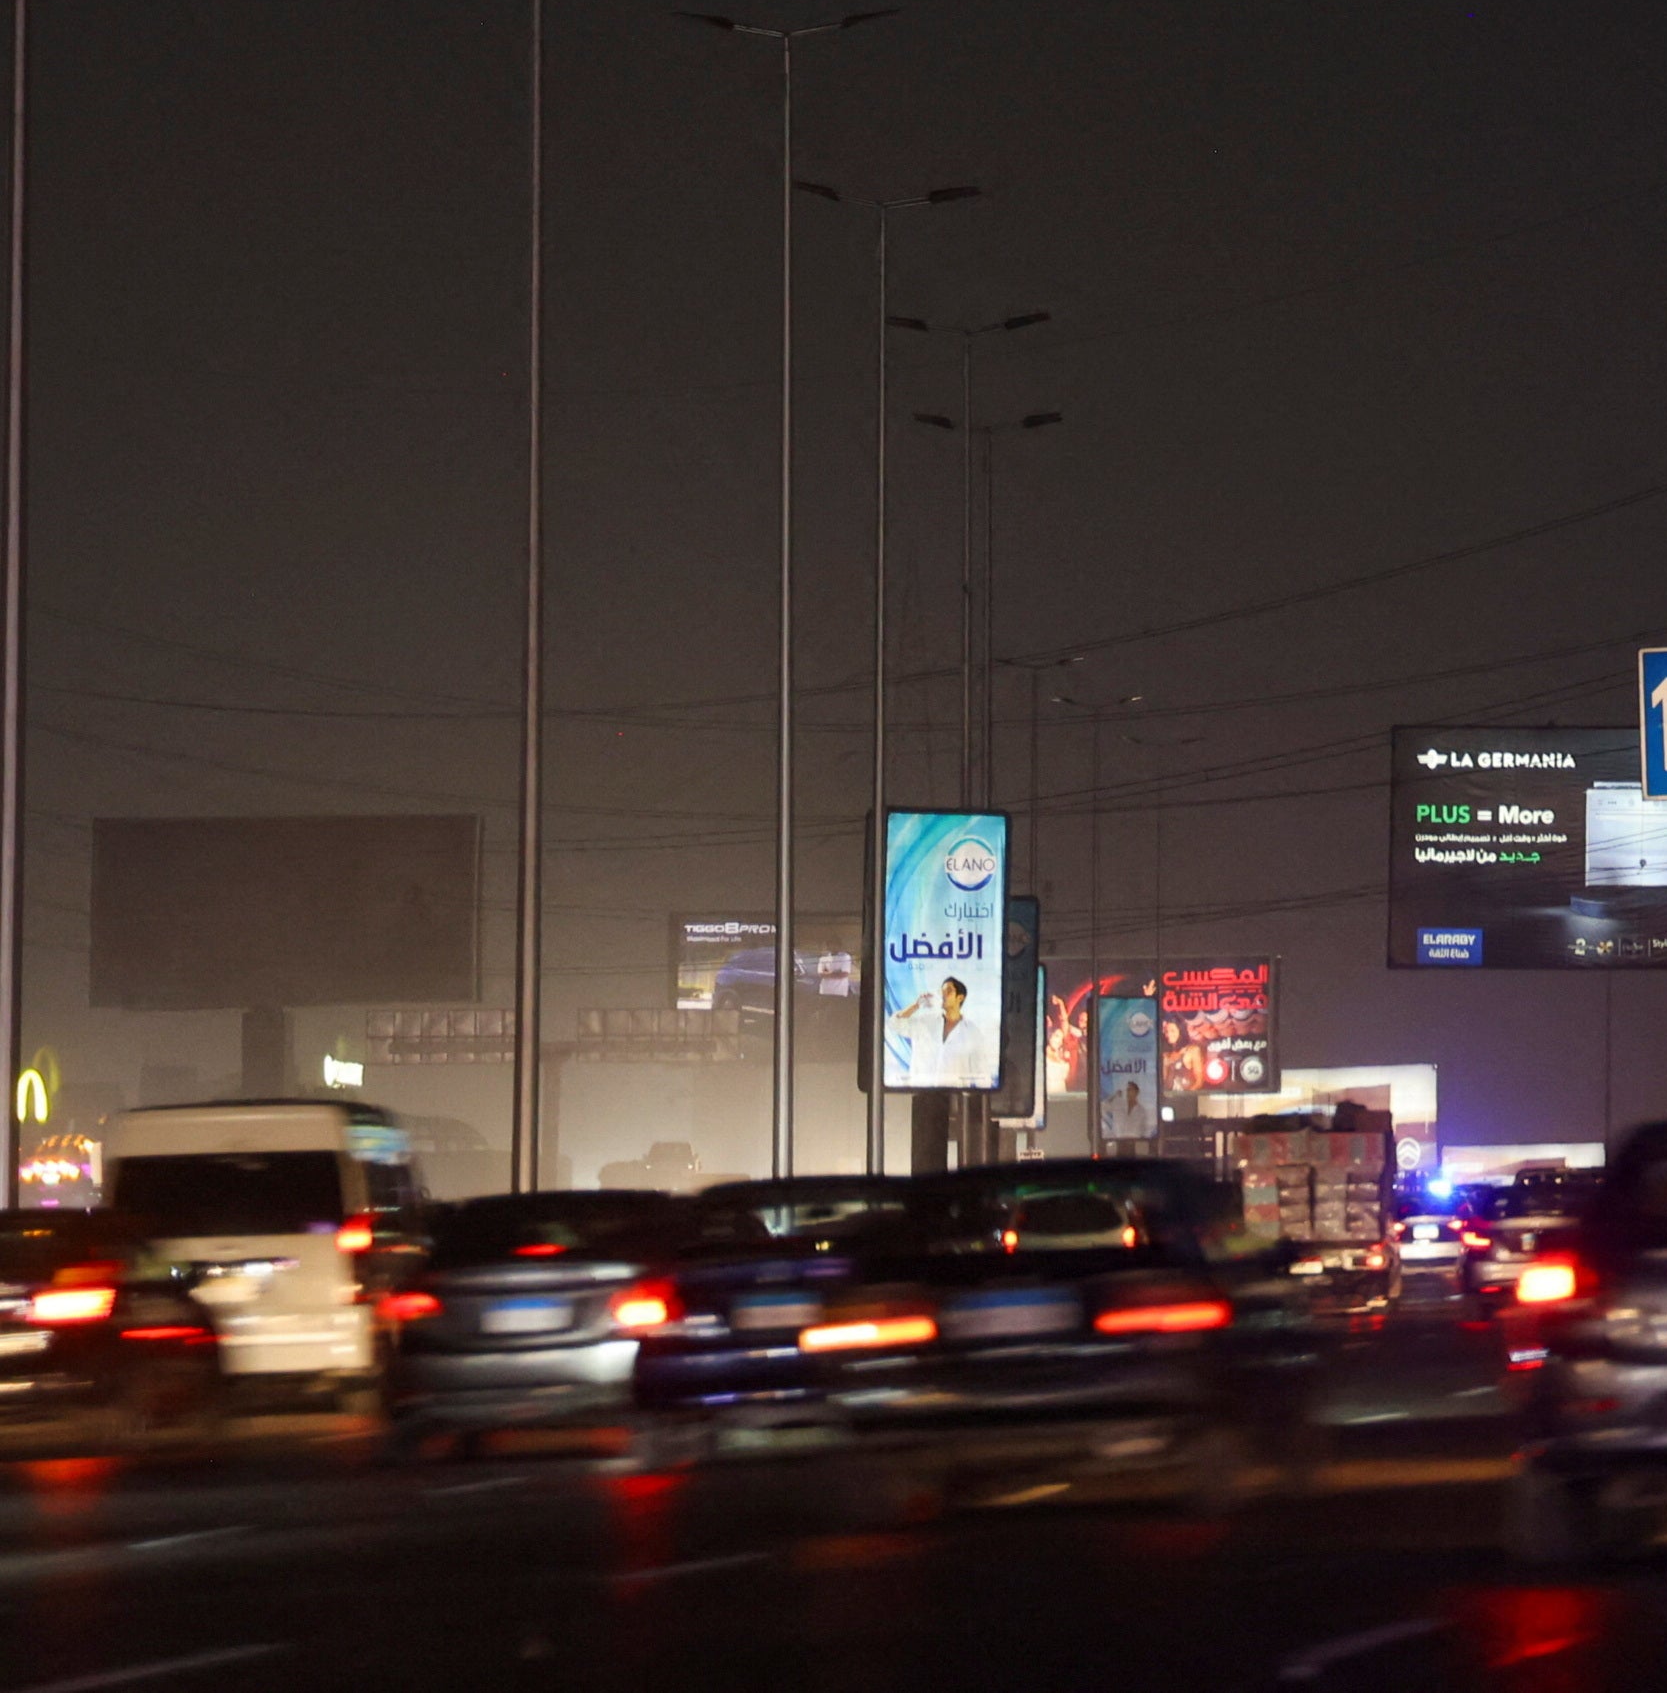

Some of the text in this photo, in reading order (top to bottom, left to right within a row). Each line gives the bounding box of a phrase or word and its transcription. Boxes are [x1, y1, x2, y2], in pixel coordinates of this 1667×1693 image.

[1450, 751, 1577, 769] LA GERMANIA
[1416, 804, 1471, 824] PLUS
[1498, 804, 1555, 825] More
[945, 858, 996, 872] ELANO
[889, 928, 983, 963] الأفضل
[1422, 933, 1476, 945] ELARABY
